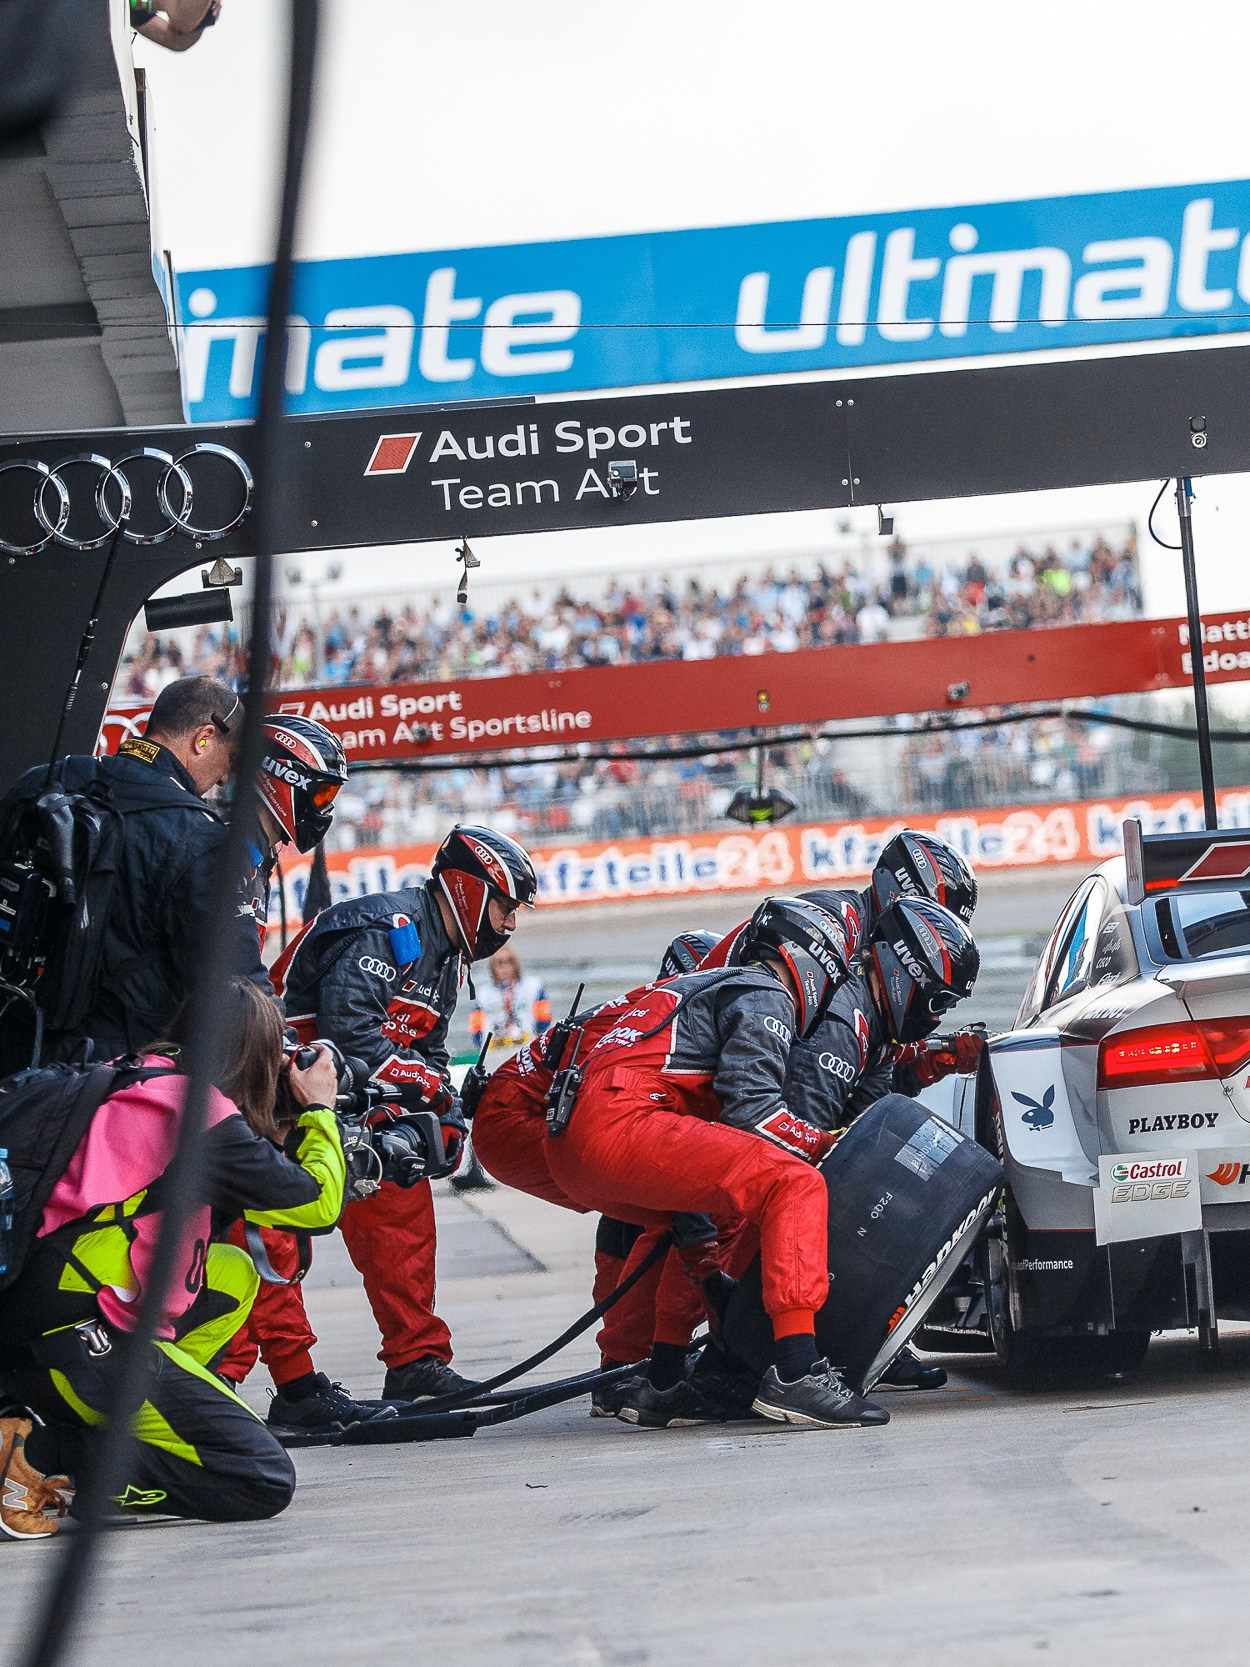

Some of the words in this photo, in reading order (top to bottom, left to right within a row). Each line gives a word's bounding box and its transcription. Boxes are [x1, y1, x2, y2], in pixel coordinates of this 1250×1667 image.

[429, 423, 539, 463] Audi
[555, 416, 692, 459] Sport
[431, 478, 560, 511] Team
[575, 467, 660, 501] At
[308, 696, 374, 723] Audi
[380, 690, 462, 720] Sport
[450, 708, 593, 743] Sportsline
[262, 755, 313, 791] uvex
[894, 867, 920, 897] uve
[808, 941, 842, 984] uvex
[893, 939, 932, 989] uvex
[1128, 1112, 1220, 1136] PLAYBOY
[1130, 1160, 1184, 1181] Castrol
[1110, 1180, 1192, 1203] EDGE
[856, 1226, 868, 1237] N
